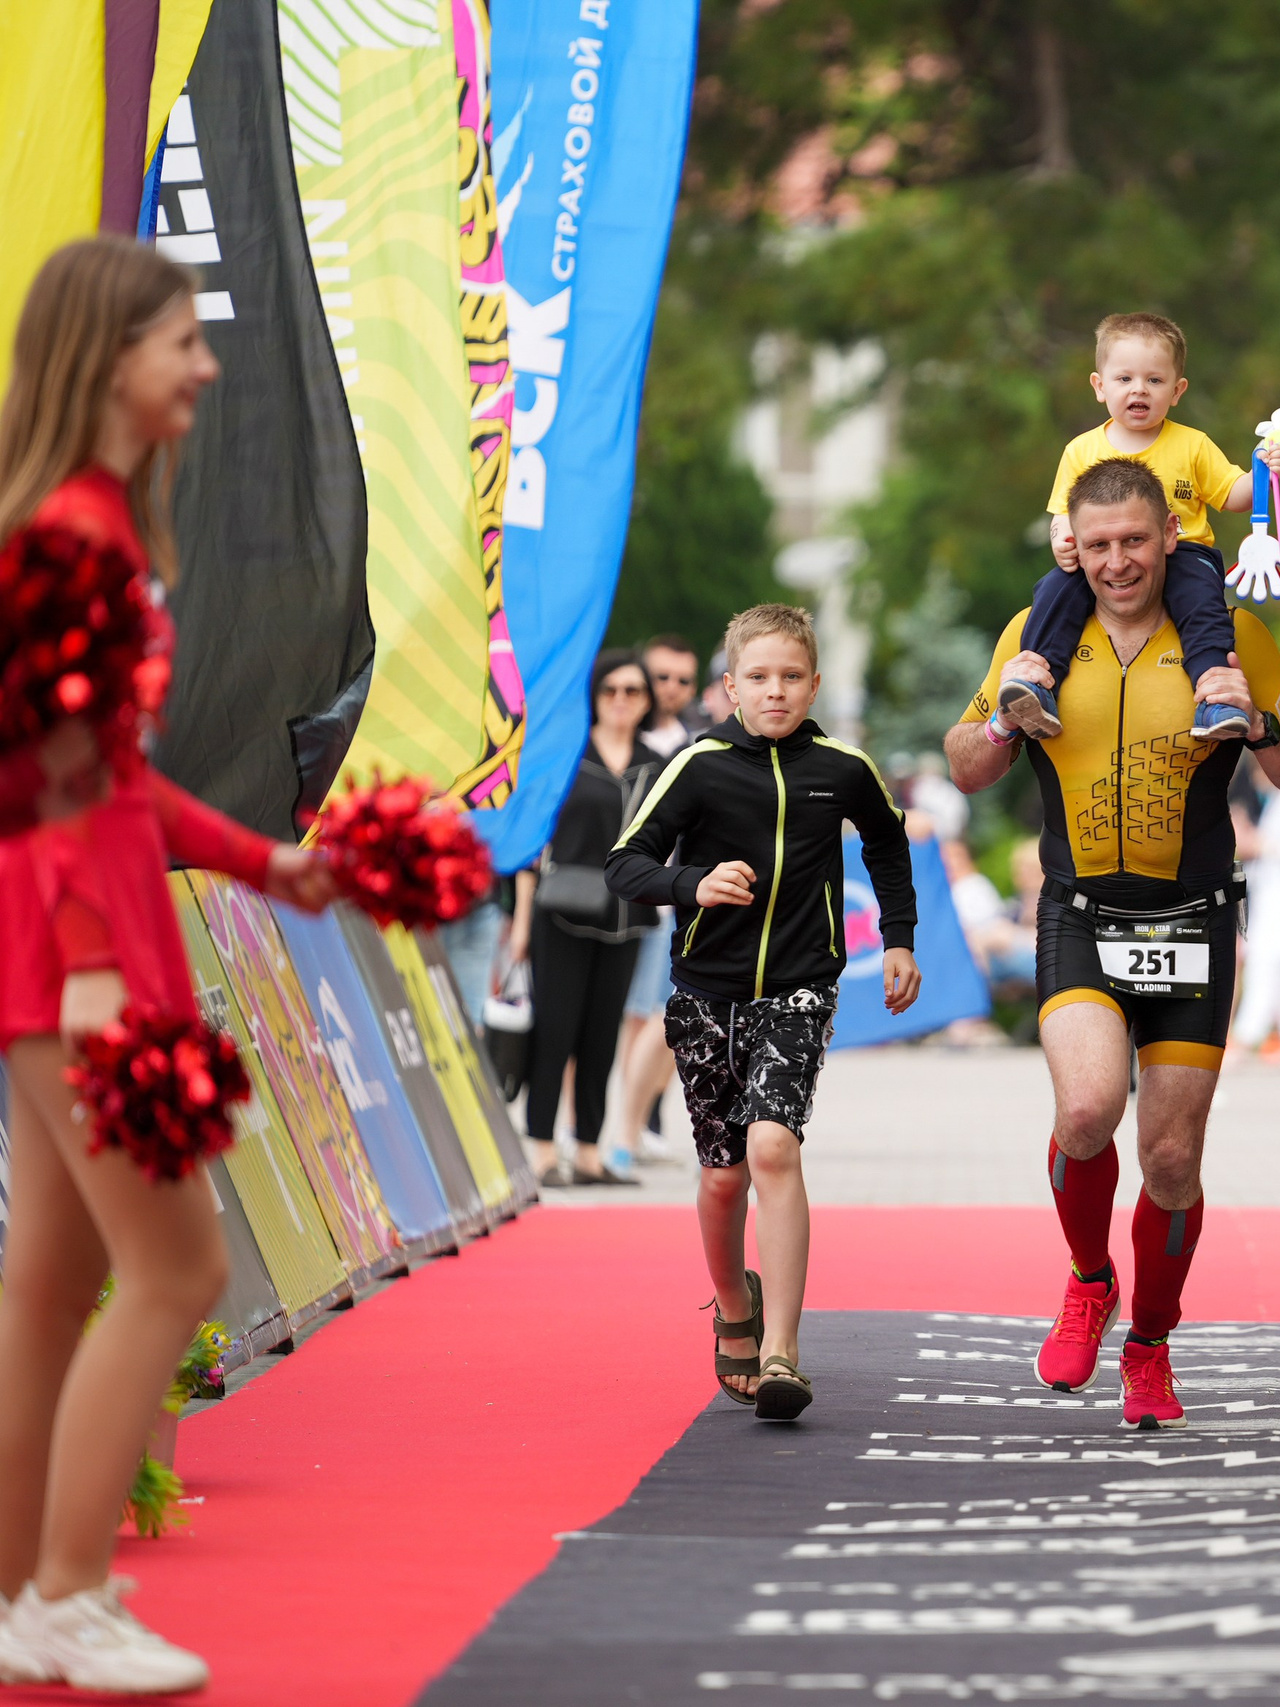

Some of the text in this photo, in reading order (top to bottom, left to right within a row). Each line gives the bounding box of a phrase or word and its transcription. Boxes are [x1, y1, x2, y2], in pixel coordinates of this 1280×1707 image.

[552, 36, 603, 282] СТРАХОВОЙ
[1175, 479, 1190, 488] STAR
[1174, 489, 1192, 500] KIDS
[1134, 925, 1149, 933] IRON
[1128, 949, 1176, 976] 251
[1134, 983, 1172, 993] VLADIMIR
[864, 1447, 1160, 1462] IRON
